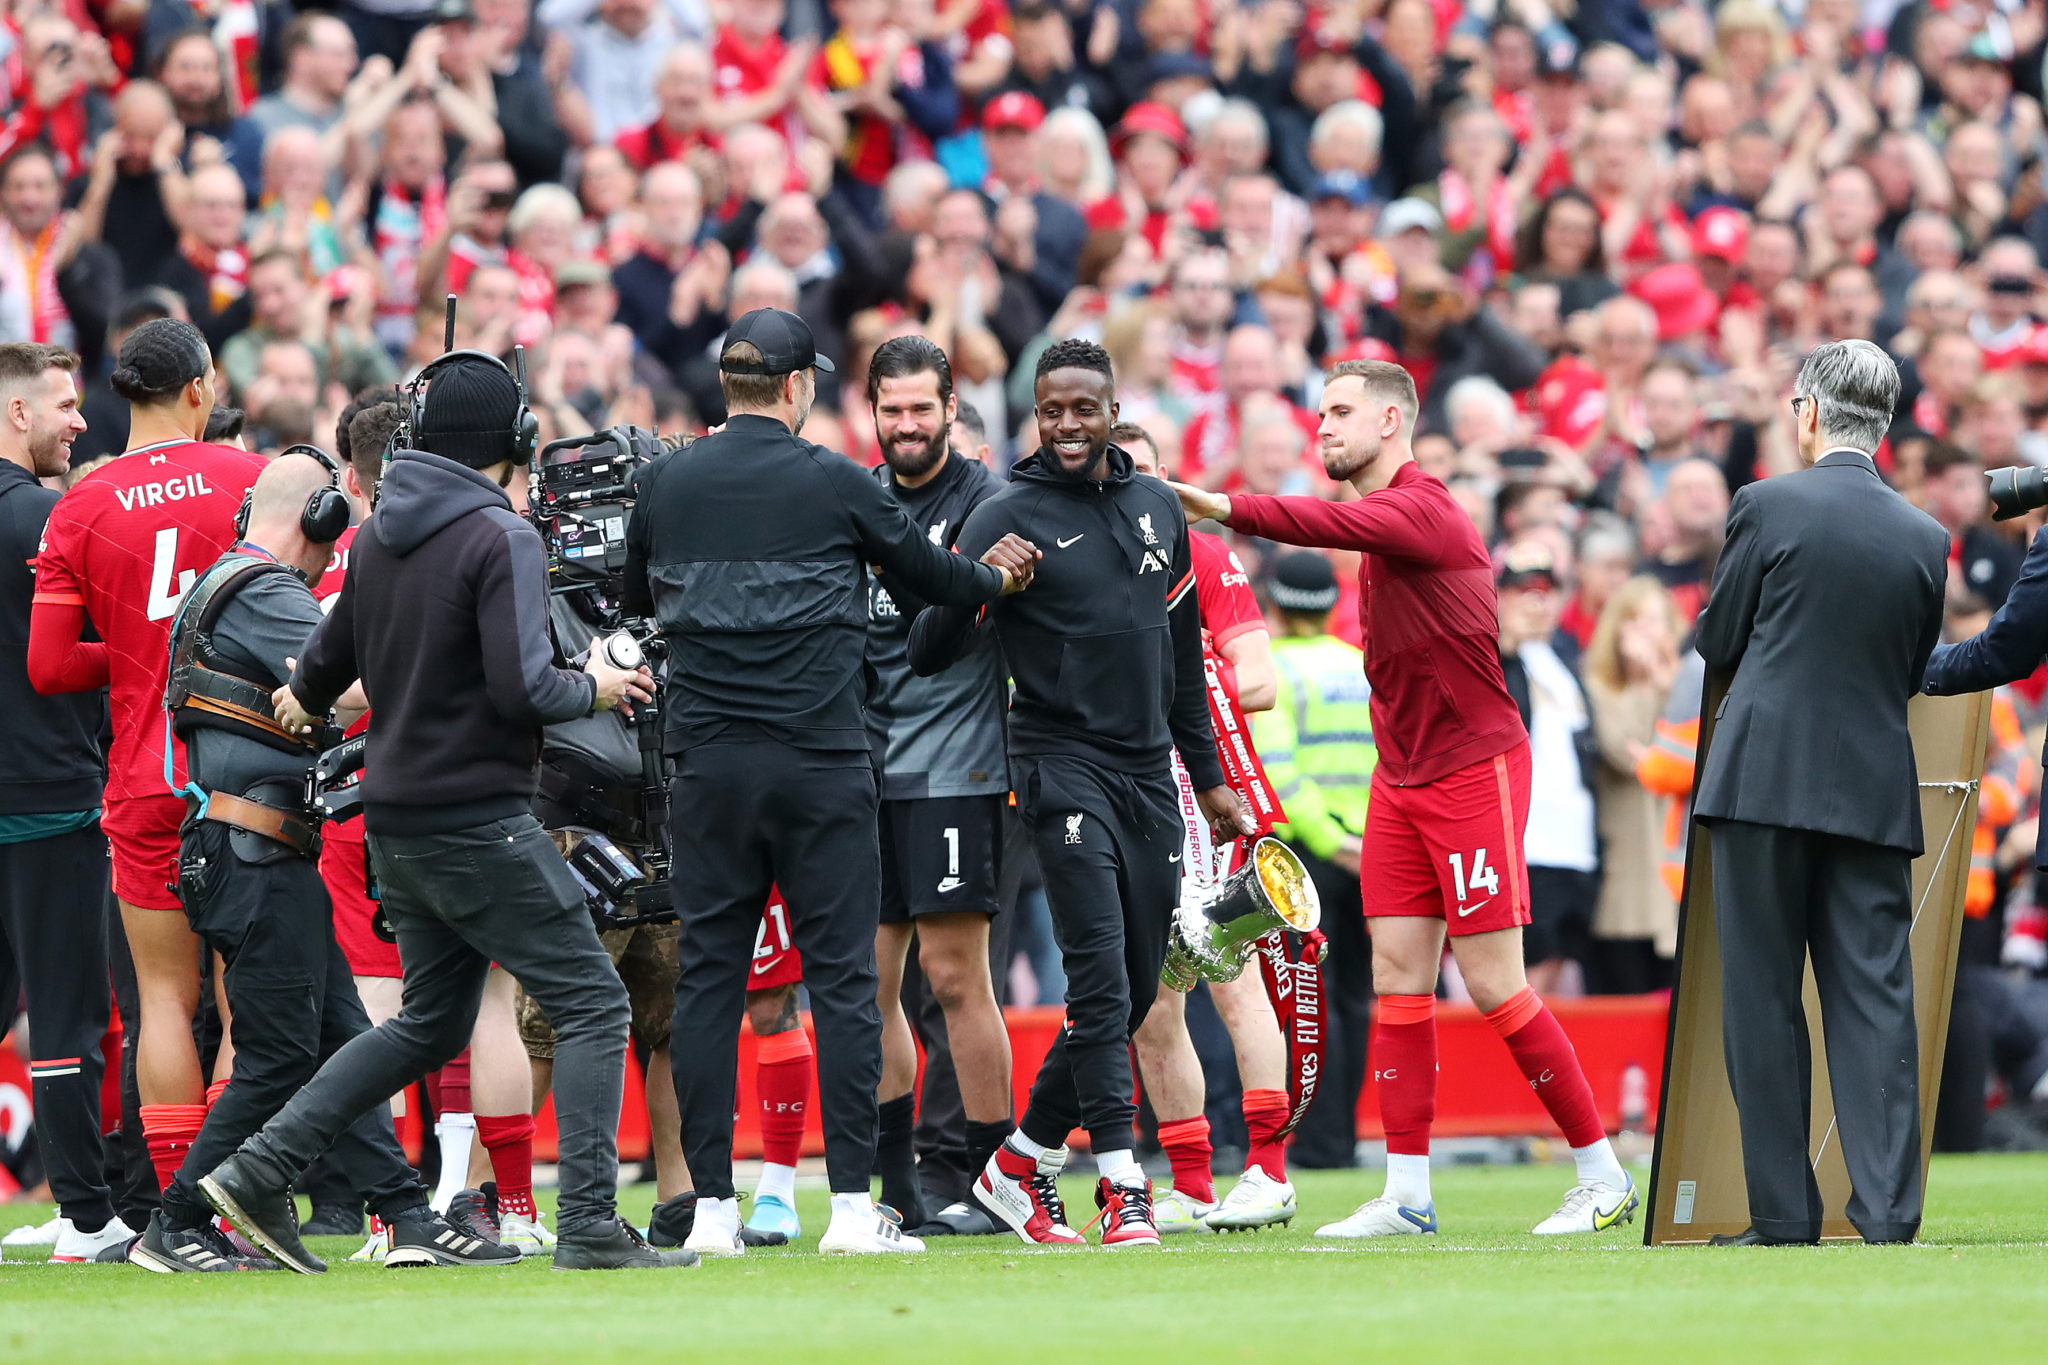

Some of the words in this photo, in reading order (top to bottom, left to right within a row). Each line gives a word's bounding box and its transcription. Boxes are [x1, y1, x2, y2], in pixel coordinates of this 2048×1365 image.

[114, 472, 213, 511] VIRGIL
[146, 527, 199, 622] 4
[1230, 733, 1258, 777] ENERGY
[1249, 779, 1274, 815] DRINK
[943, 828, 959, 875] 1
[1187, 820, 1203, 867] ENERGY
[1448, 848, 1499, 902] 14
[753, 904, 791, 960] 21
[1295, 961, 1319, 1015] BETTER
[1297, 1018, 1319, 1044] FLY
